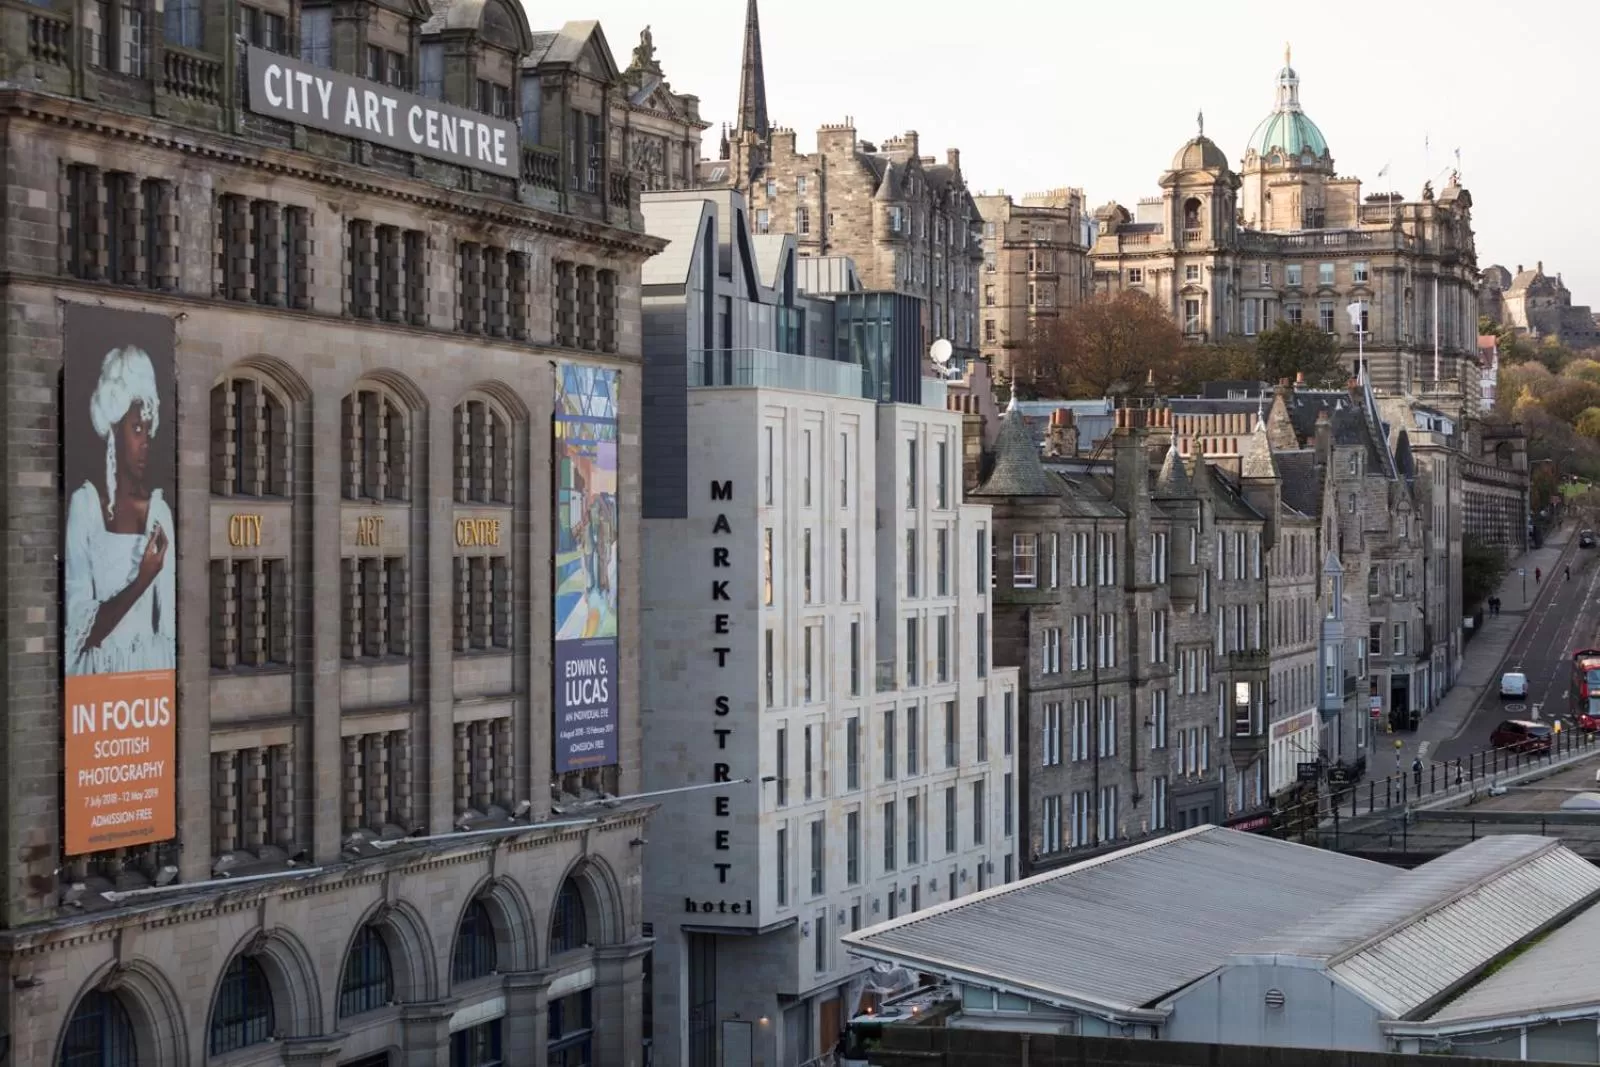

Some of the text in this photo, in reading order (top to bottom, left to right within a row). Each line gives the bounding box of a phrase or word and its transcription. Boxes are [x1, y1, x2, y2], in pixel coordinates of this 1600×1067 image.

[264, 64, 507, 166] CITY ART CENTRE
[228, 513, 501, 547] CITY ART CENTRE
[566, 657, 608, 678] EDWIN G.
[565, 677, 609, 706] LUCAS
[711, 480, 733, 884] MARKET STREET
[72, 696, 170, 735] IN FOCUS
[93, 736, 150, 759] SCOTTISH
[78, 761, 165, 788] PHOTOGRAPHY
[90, 795, 102, 808] July
[103, 793, 118, 805] 2018
[122, 791, 130, 802] 12
[131, 790, 144, 803] May
[144, 787, 159, 799] 2019
[91, 807, 153, 828] ADMISSION FREE
[684, 897, 753, 915] hotel
